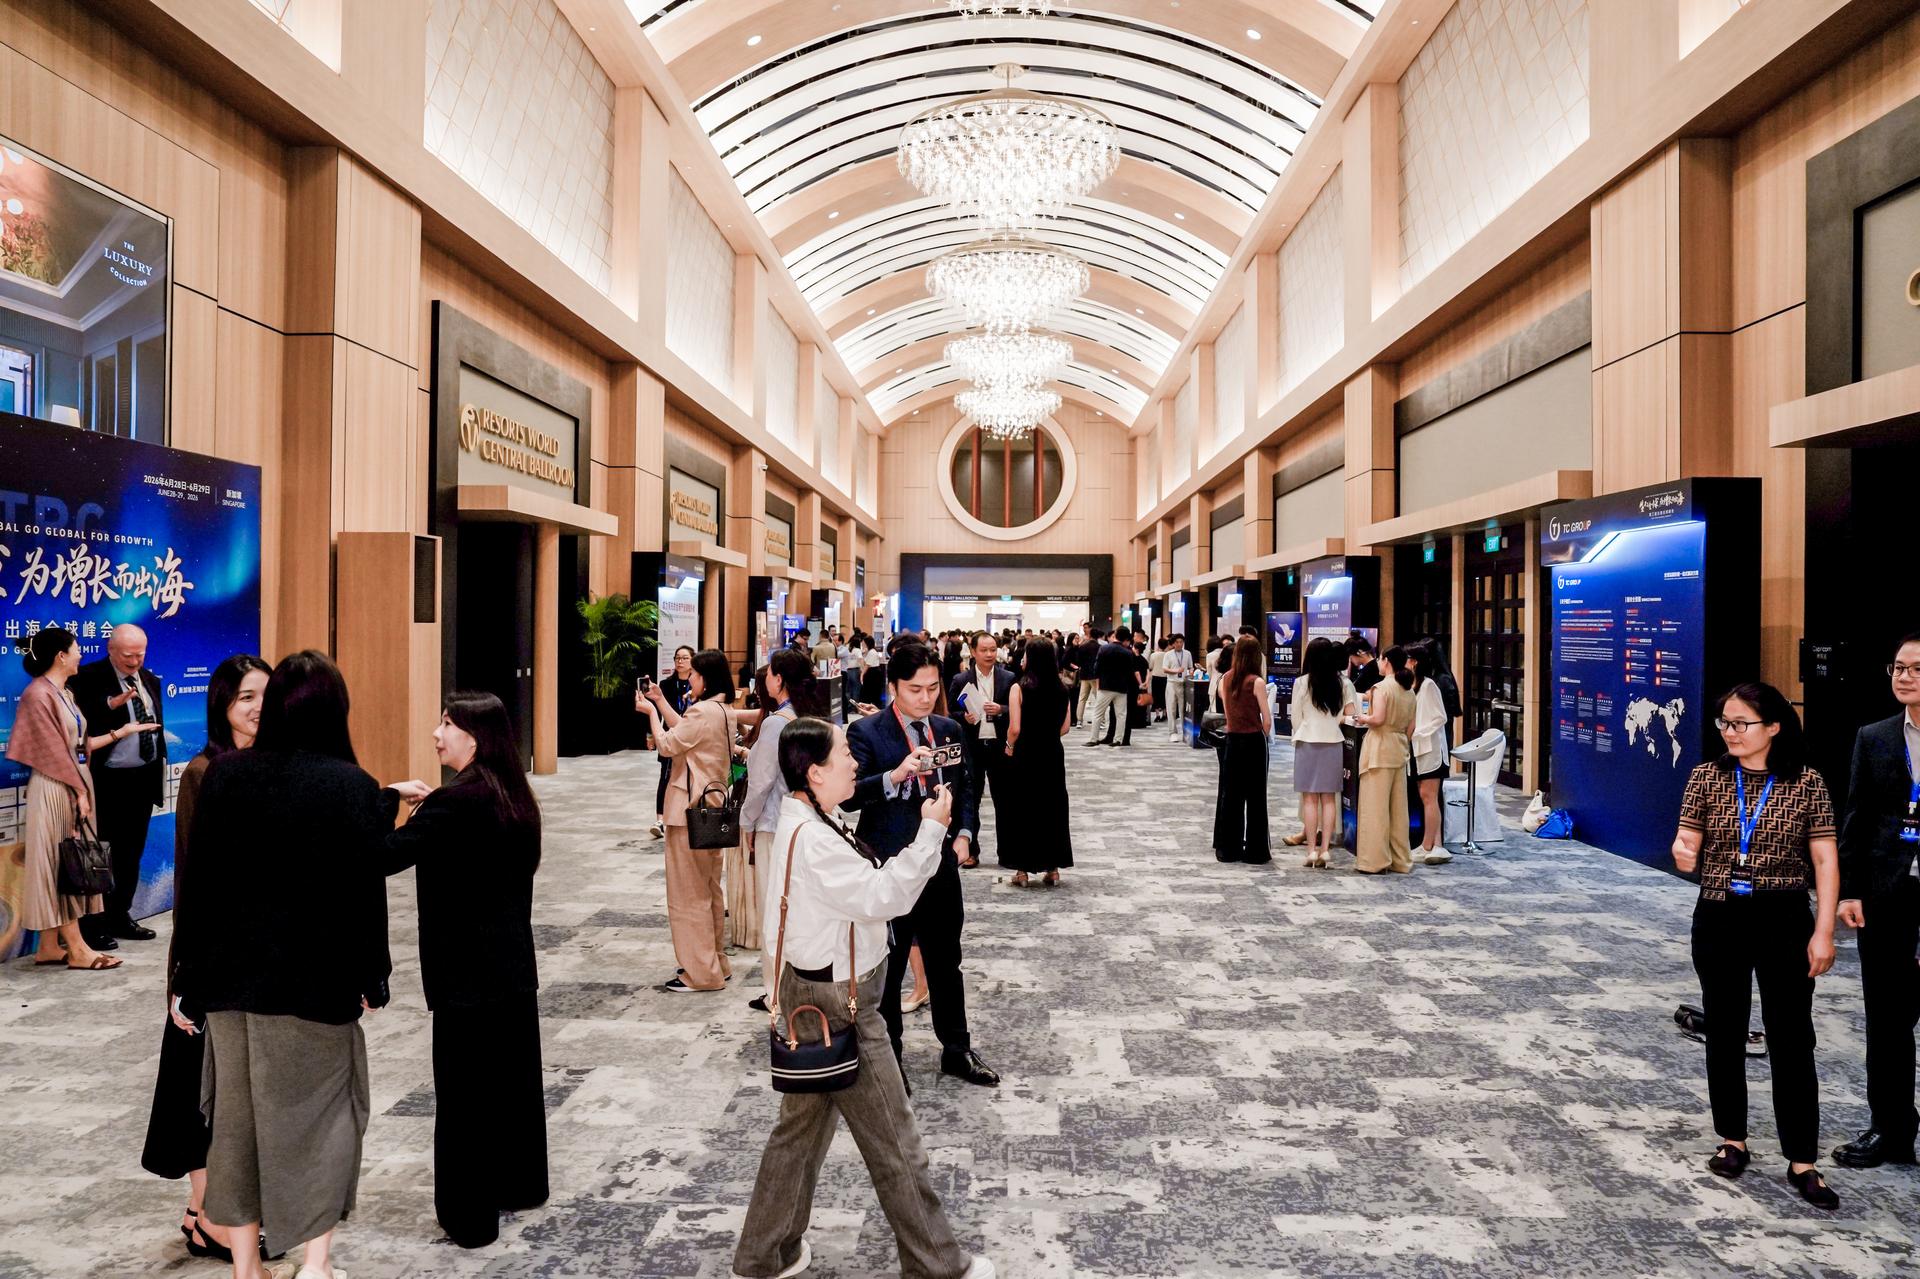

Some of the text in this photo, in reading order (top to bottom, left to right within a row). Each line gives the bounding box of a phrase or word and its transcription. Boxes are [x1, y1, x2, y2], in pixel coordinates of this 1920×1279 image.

[123, 241, 135, 252] THE
[104, 247, 153, 276] LUXURY
[110, 266, 148, 287] COLLECTION
[482, 408, 560, 457] RESORTS WORLD
[482, 439, 576, 488] CENTRAL BALLROOM
[222, 499, 247, 509] SINGAPORE
[25, 524, 40, 534] GO
[45, 527, 86, 539] GLOBAL
[91, 532, 110, 542] FOR
[114, 535, 153, 546] GROWTH
[1571, 520, 1592, 533] GROUP
